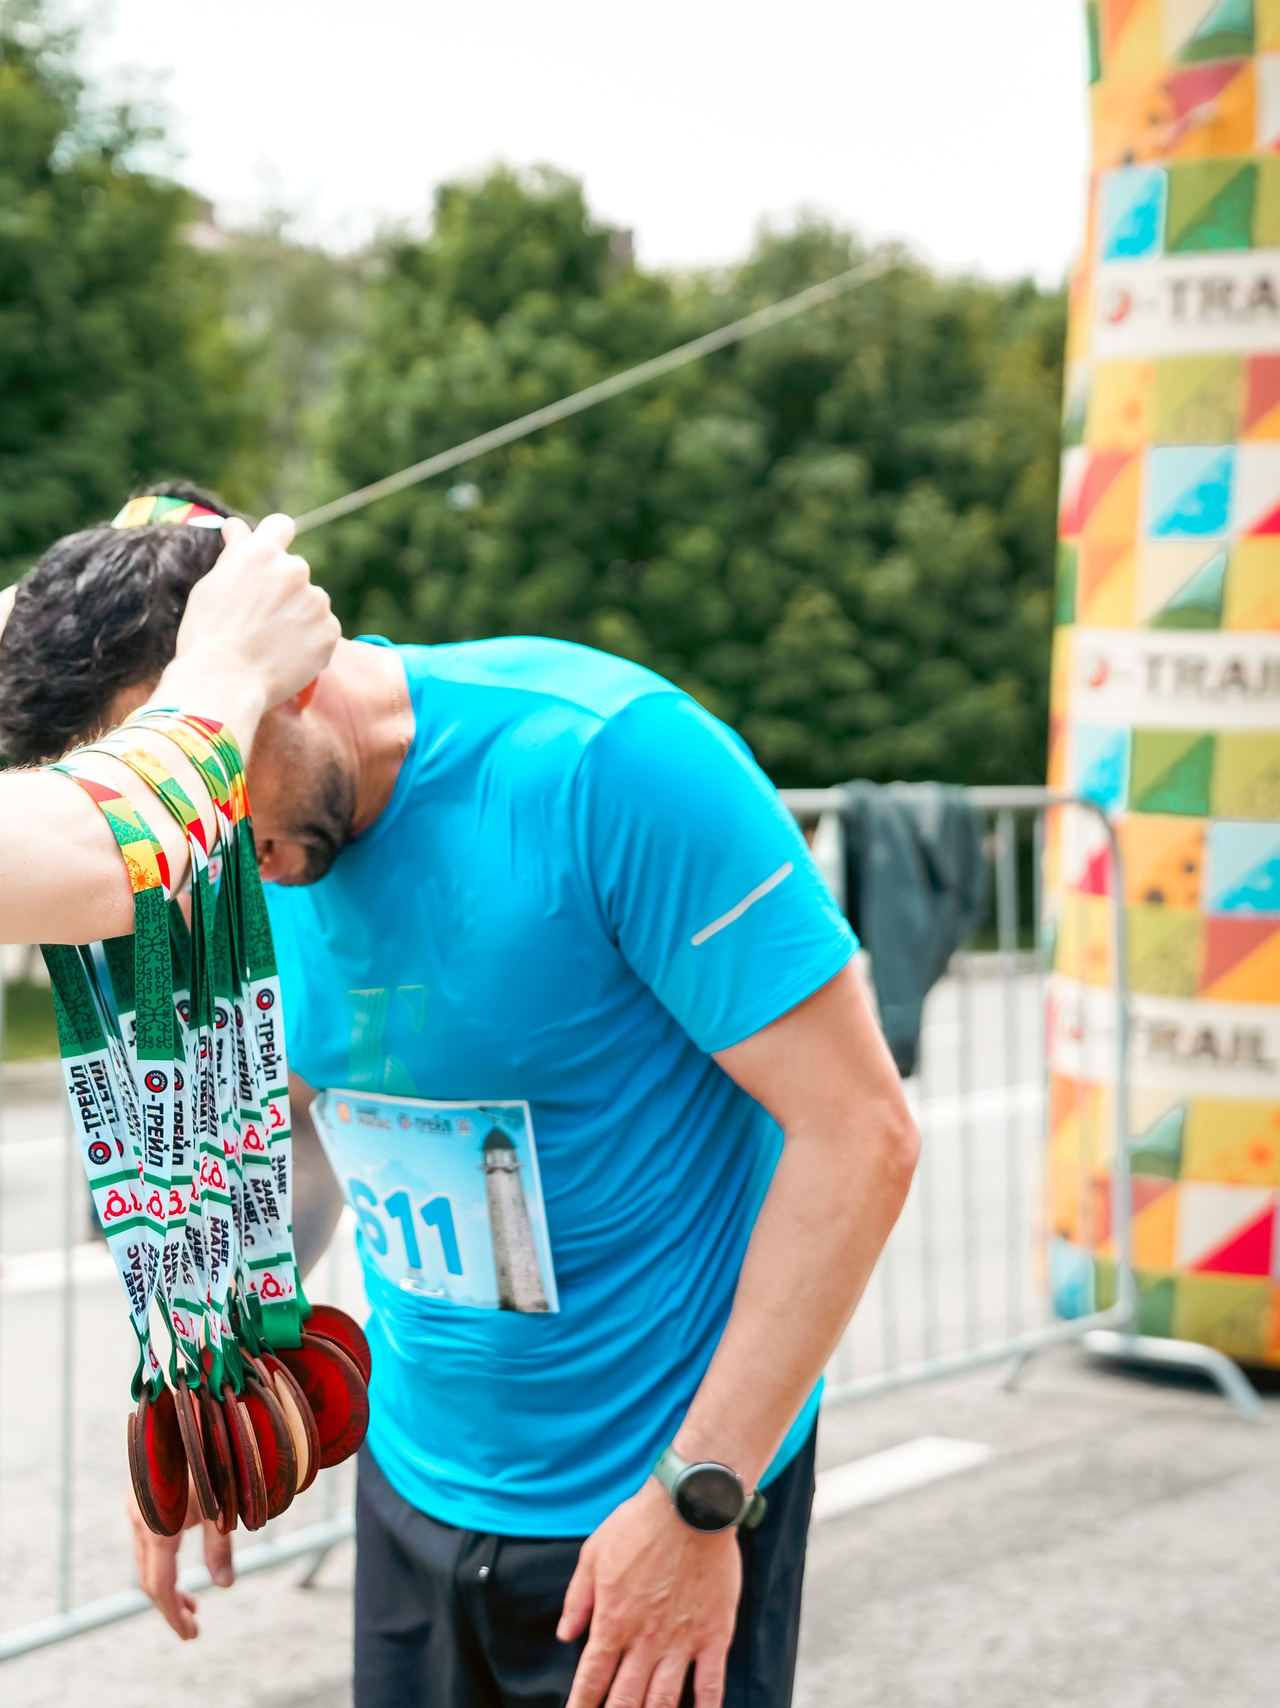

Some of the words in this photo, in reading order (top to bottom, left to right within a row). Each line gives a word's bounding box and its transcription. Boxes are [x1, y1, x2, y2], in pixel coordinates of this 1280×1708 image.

[276, 1154, 287, 1195] ЗАБЕГ
[261, 1179, 280, 1220] ЗАБЕГ
[192, 1228, 205, 1271] ЗАБЕГ
[210, 1216, 221, 1284] МАГАС
[221, 1219, 229, 1267] ЗАБЕГ
